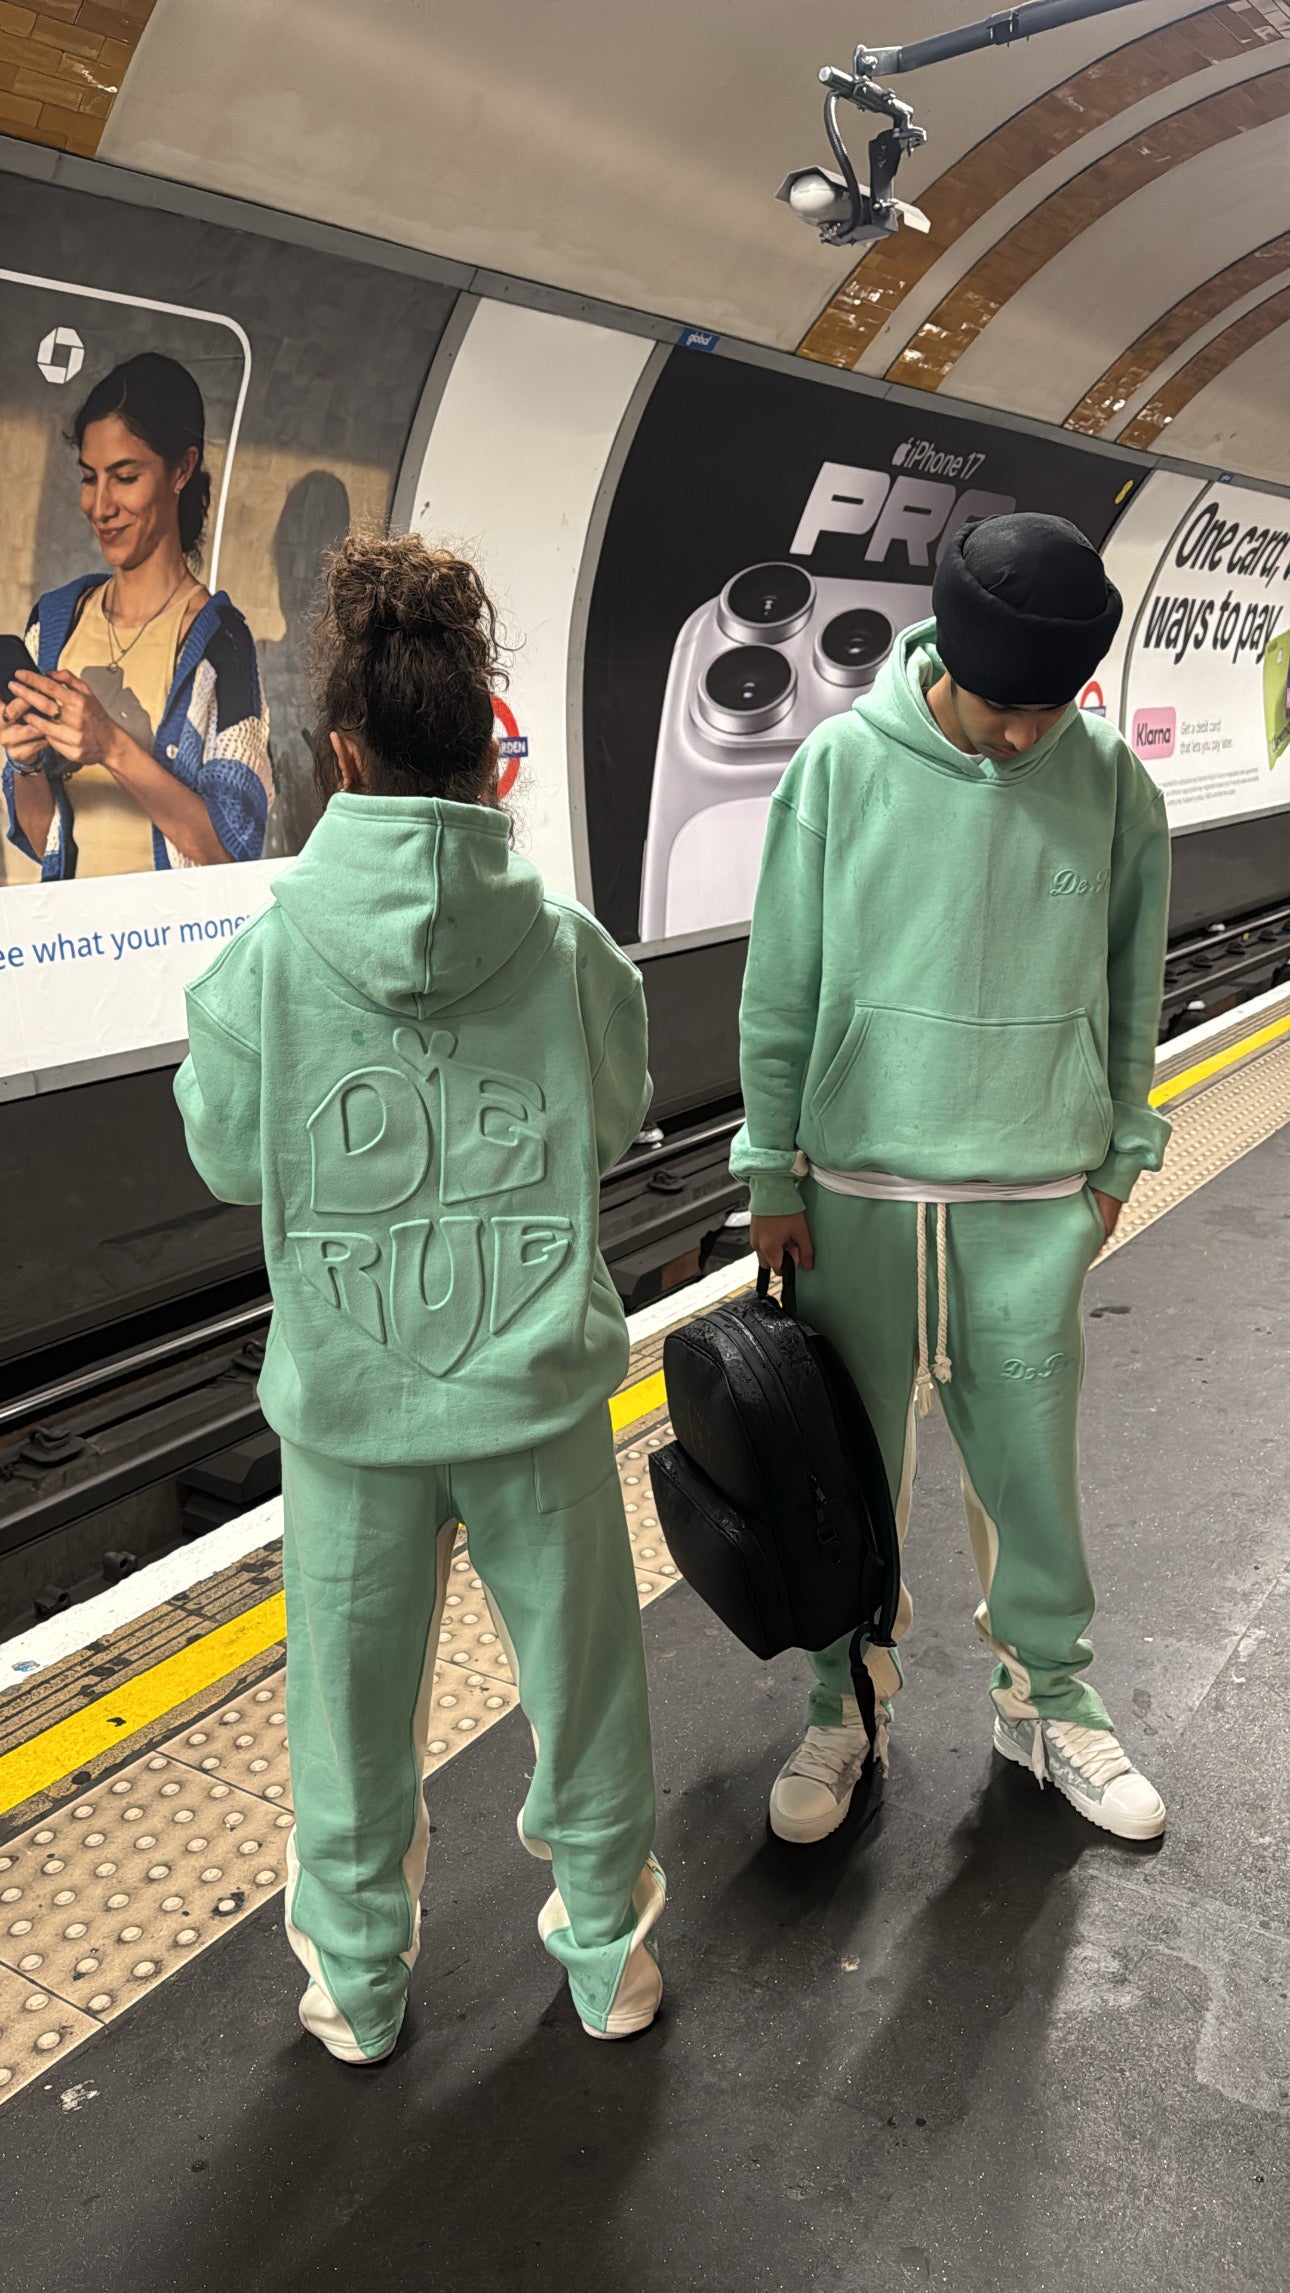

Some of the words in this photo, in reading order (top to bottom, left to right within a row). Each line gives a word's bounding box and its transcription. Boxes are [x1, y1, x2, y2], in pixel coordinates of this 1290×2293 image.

[903, 439, 964, 478] iPhone
[960, 451, 987, 480] 17
[1175, 501, 1240, 572] One
[1226, 525, 1290, 588] card,
[1142, 595, 1215, 666] ways
[1212, 589, 1241, 651] to
[1231, 602, 1284, 665] pay
[499, 740, 526, 755] RDEN
[1136, 721, 1171, 747] Klarna
[32, 930, 105, 964] what
[111, 925, 171, 960] your
[180, 914, 250, 943] mone
[286, 1215, 573, 1378] RUE
